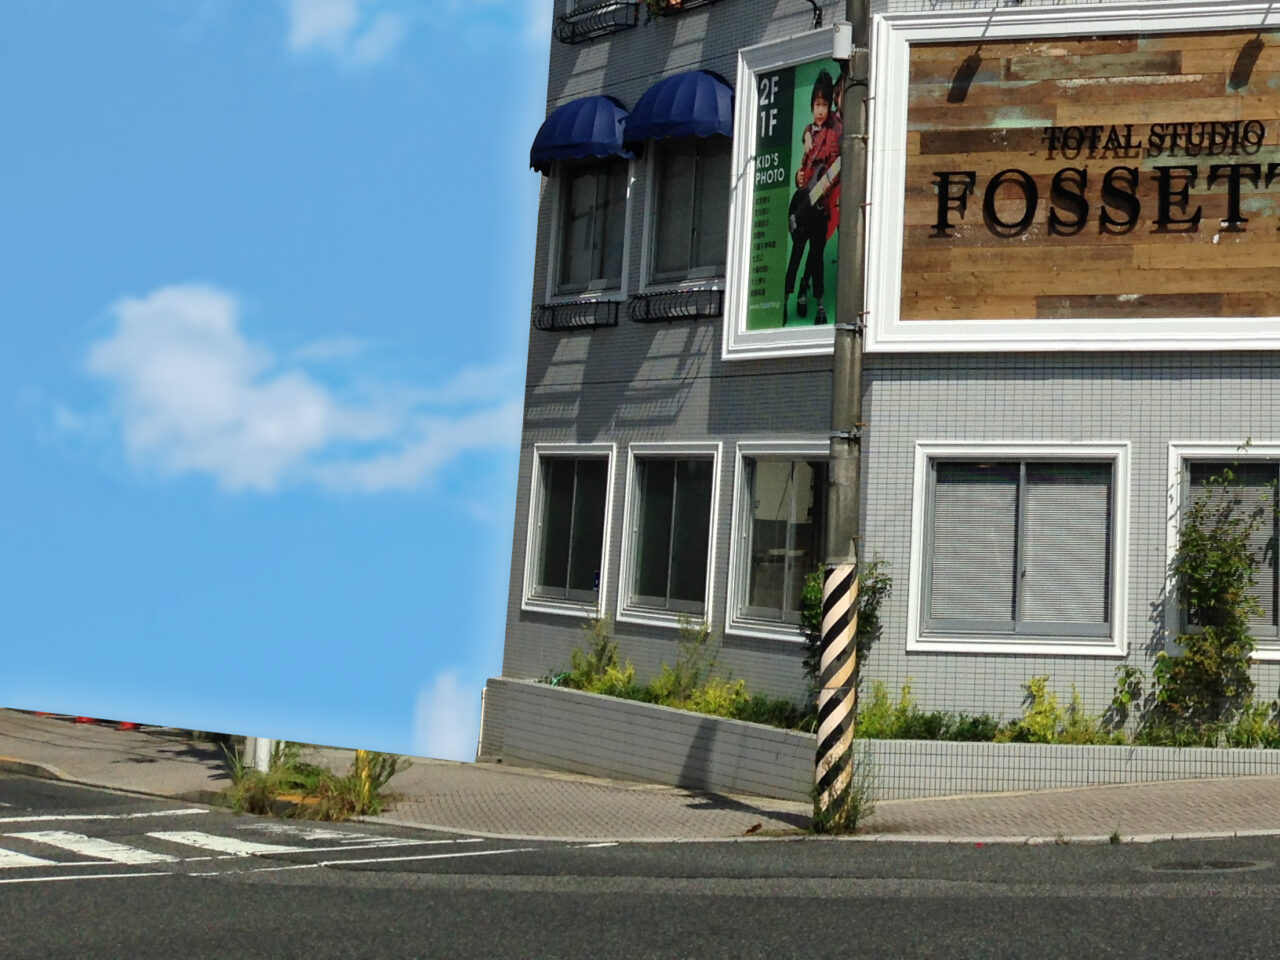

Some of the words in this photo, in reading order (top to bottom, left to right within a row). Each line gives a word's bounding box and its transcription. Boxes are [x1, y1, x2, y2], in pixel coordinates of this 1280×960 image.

[759, 76, 780, 106] 2F
[760, 108, 778, 138] 1F
[1044, 123, 1142, 151] TOTAL
[1149, 119, 1266, 148] STUDIO
[756, 153, 779, 169] KID'S
[755, 167, 785, 186] PHOTO
